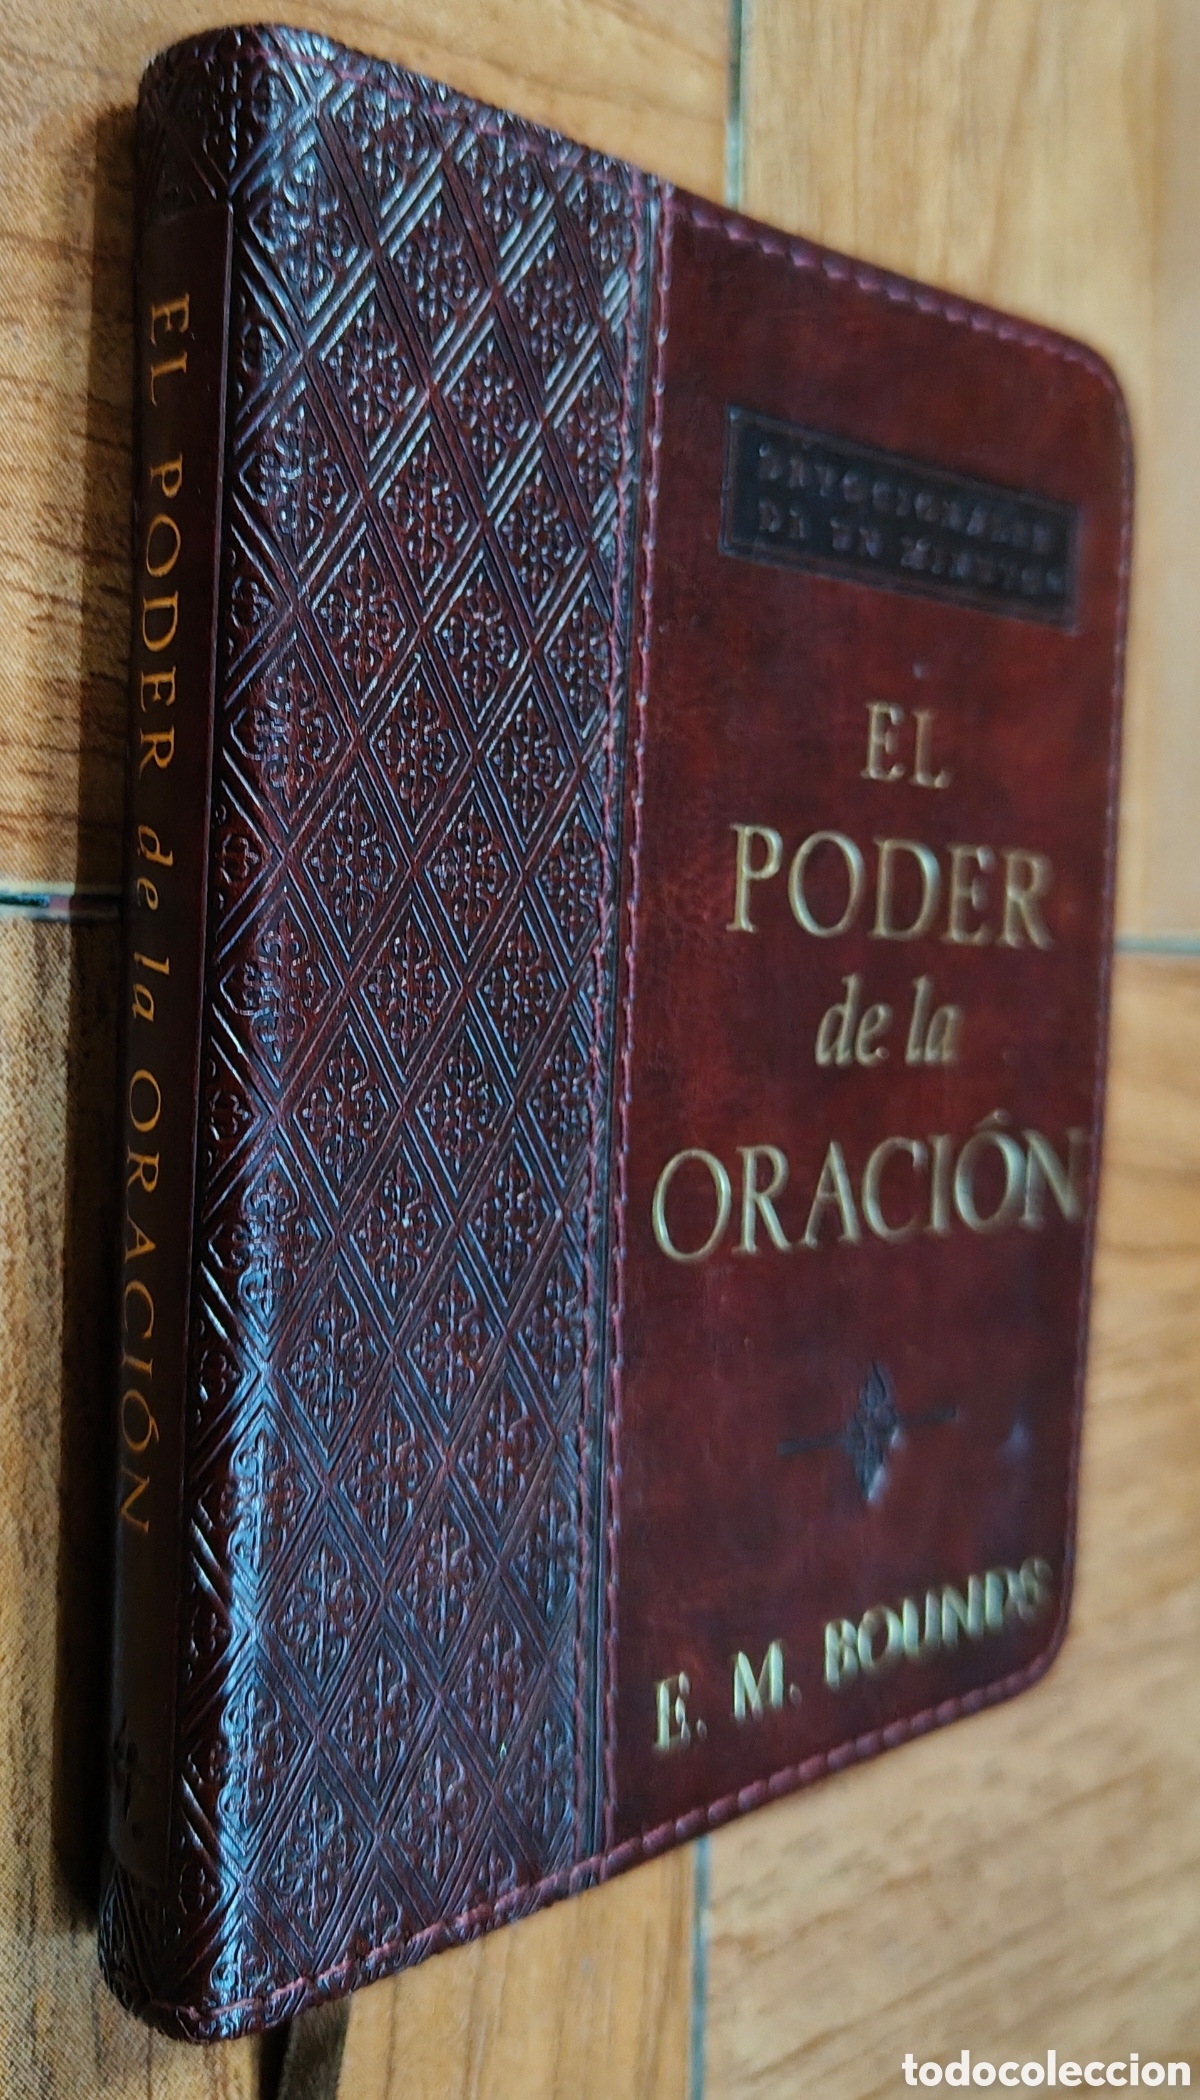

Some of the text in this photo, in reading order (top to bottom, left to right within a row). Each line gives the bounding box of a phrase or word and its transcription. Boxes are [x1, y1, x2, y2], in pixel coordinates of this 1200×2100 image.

[860, 701, 952, 790] EL
[120, 294, 190, 1534] EL PODER de la ORACIÓN
[726, 822, 1054, 951] PODER
[814, 972, 963, 1067] de la
[651, 1108, 1090, 1263] ORACIÓN
[653, 1556, 1054, 1754] E. M. BOUNDS
